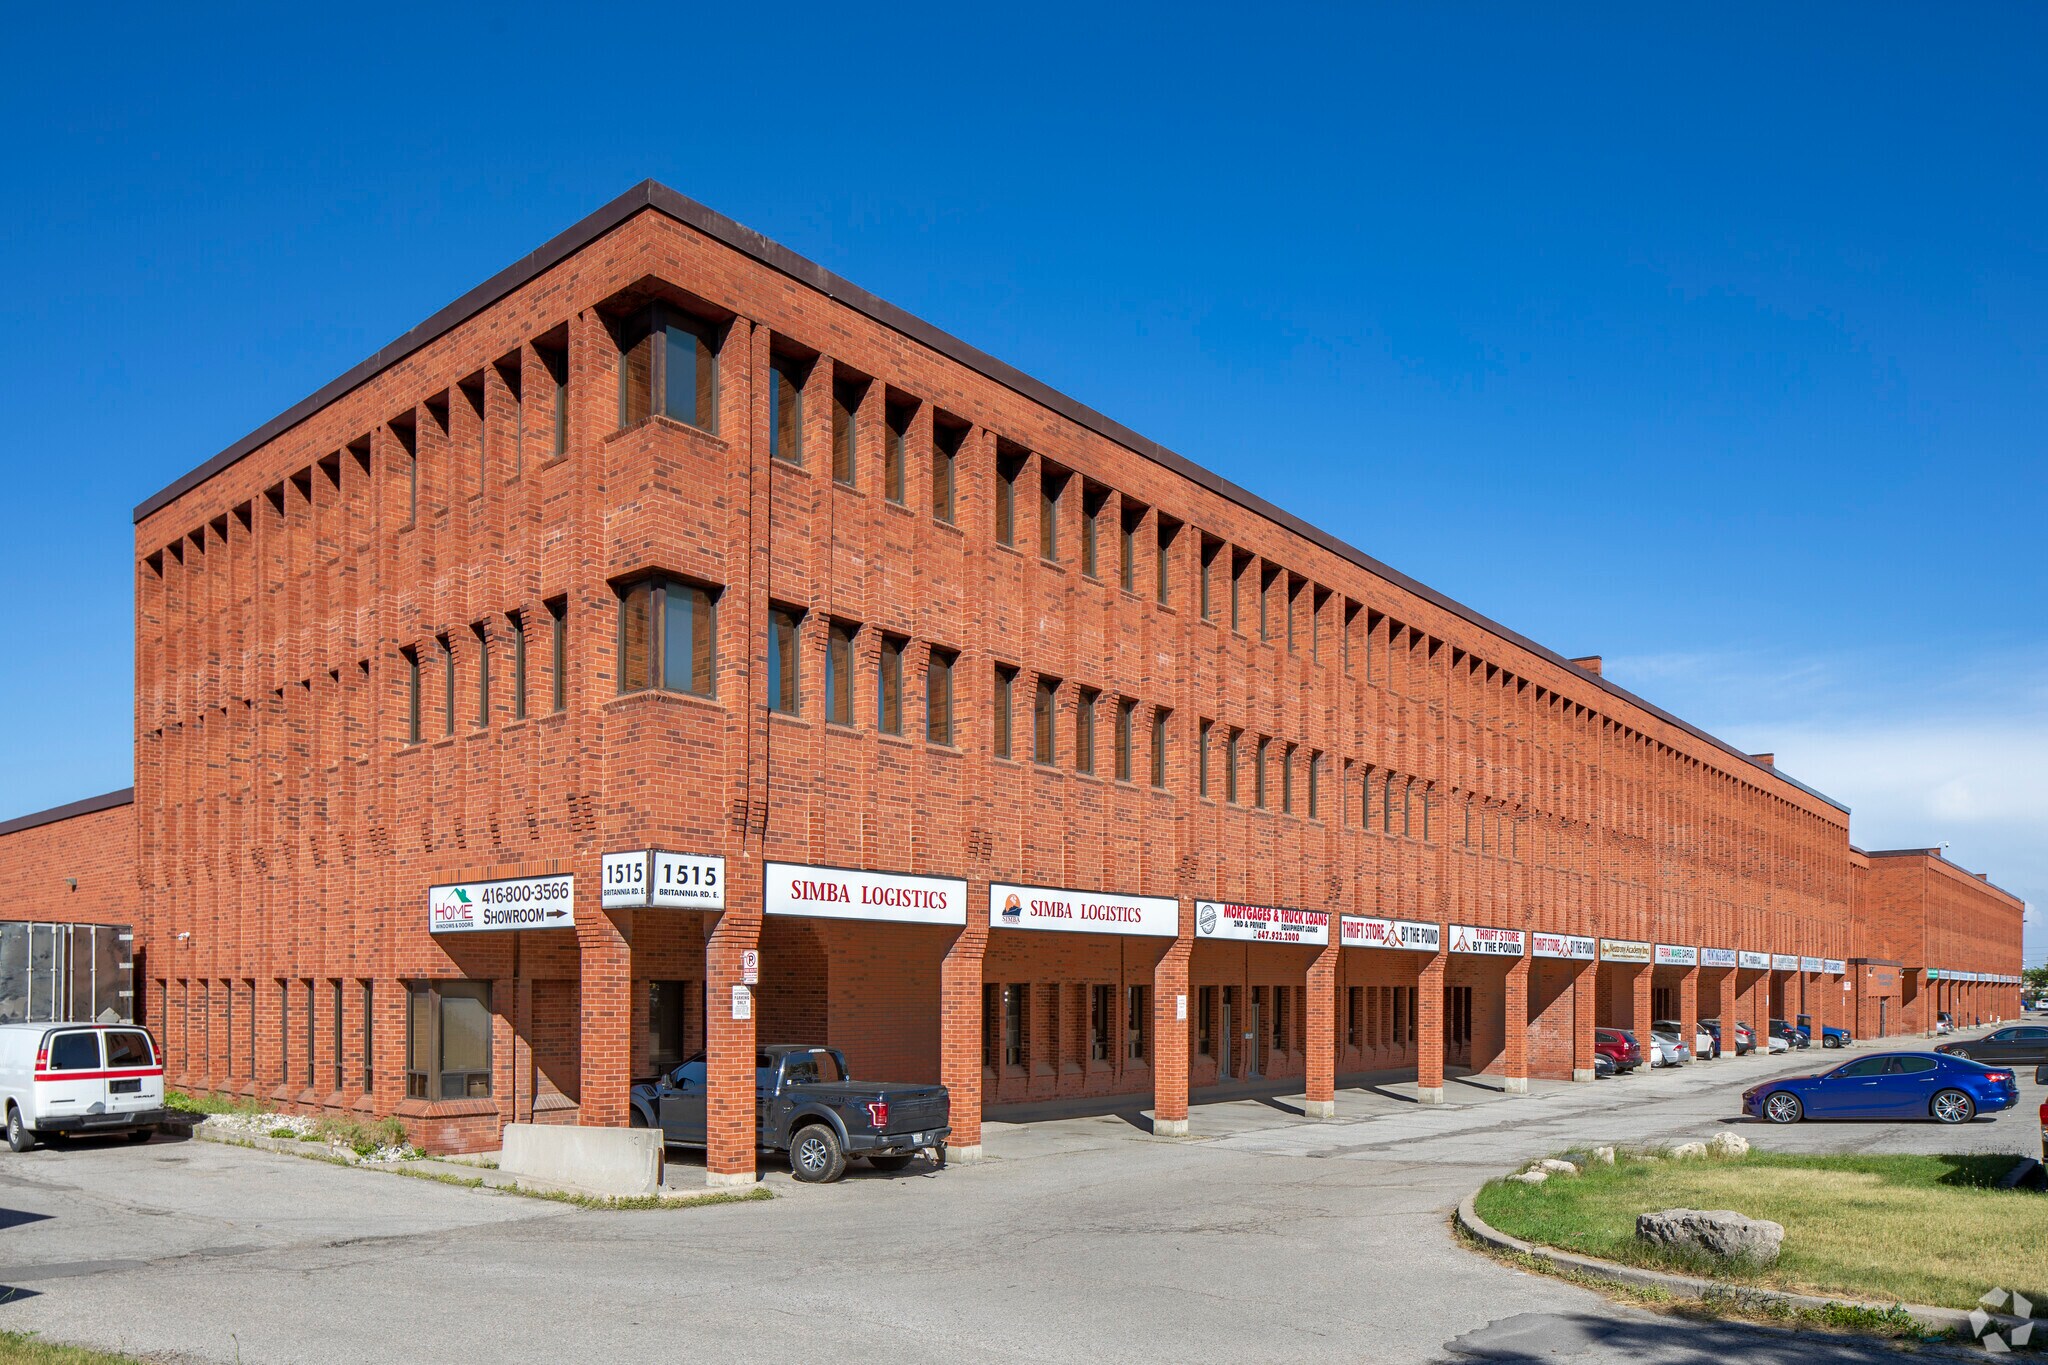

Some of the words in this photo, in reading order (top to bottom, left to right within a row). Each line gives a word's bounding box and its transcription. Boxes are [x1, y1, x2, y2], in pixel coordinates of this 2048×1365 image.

[607, 862, 643, 884] 1515
[663, 864, 716, 886] 1515
[482, 882, 569, 904] 416-800-3566
[604, 888, 630, 896] BRITANNIA
[659, 888, 698, 897] BRITANNIA
[791, 879, 850, 903] SIMBA
[861, 885, 947, 909] LOGISTICS
[435, 902, 473, 920] HOME
[483, 908, 544, 925] SHOWROOM
[1030, 899, 1072, 919] SIMBA
[1080, 903, 1142, 923] LOGISTICS
[1223, 904, 1271, 922] MORTGAGES
[1274, 909, 1279, 922] &
[1281, 910, 1304, 924] TRUCK
[1305, 913, 1327, 926] LOANS
[1234, 920, 1244, 928] 2ND
[1250, 921, 1266, 929] PRIVATE
[1281, 924, 1304, 932] EQUIPMENT
[1342, 921, 1364, 939] THRIFT
[1365, 922, 1384, 940] STORE
[1401, 926, 1408, 942] BY
[1410, 927, 1419, 943] THE
[1421, 928, 1438, 944] POUND
[1476, 929, 1498, 941] THRIFT
[1500, 931, 1520, 942] STORE
[1534, 937, 1547, 951] THRIFT
[1547, 939, 1559, 951] STORE
[1472, 941, 1482, 951] BY
[1484, 942, 1496, 952] THE
[1498, 942, 1521, 954] POUND
